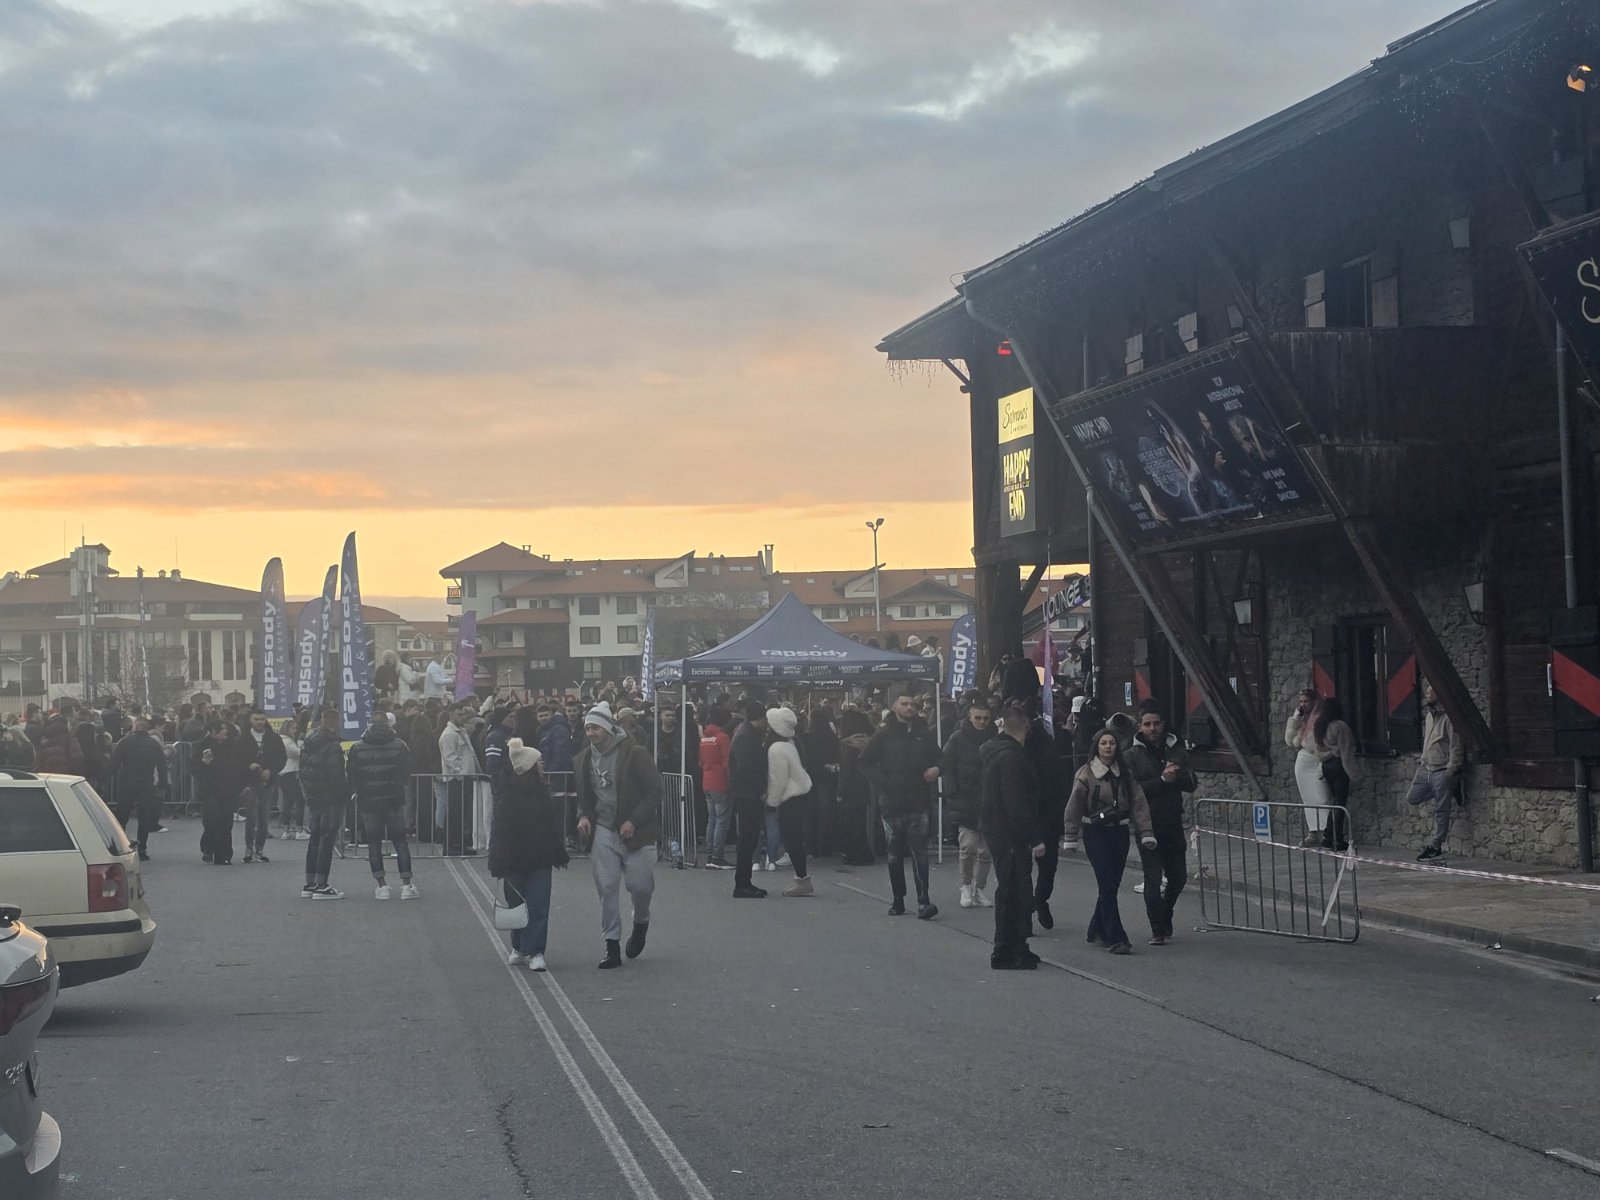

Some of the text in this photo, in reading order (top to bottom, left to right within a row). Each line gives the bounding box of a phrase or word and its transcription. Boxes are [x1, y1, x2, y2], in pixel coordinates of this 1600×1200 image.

[1072, 416, 1113, 443] HAPPY END
[1003, 448, 1031, 486] HAPPY
[1008, 489, 1026, 522] END
[1042, 577, 1082, 623] LOUNGE
[263, 600, 278, 711] rapsody
[297, 628, 317, 706] apsody
[341, 572, 359, 729] rapsody
[353, 582, 373, 720] RAVEL & EVENTS
[760, 648, 848, 658] rapsody
[280, 669, 289, 710] TRAVEL
[1257, 807, 1265, 823] P
